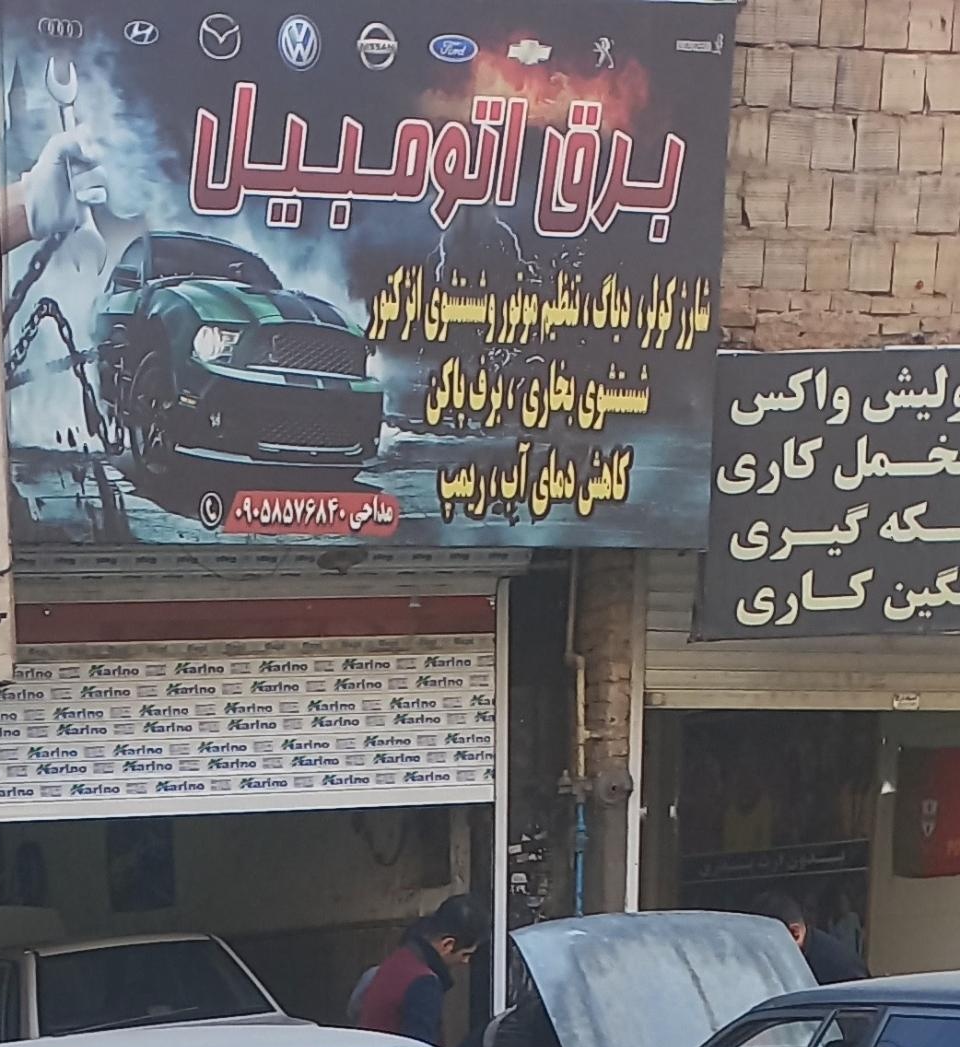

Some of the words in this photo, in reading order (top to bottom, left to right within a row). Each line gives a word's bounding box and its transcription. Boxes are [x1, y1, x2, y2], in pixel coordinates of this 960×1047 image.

[439, 40, 467, 57] Ford
[190, 81, 528, 229] اتومبیل
[536, 100, 685, 243] برق
[368, 264, 423, 341] انژکتور
[497, 271, 538, 345] موتور
[539, 268, 580, 345] تنظیم
[675, 276, 711, 350] شارژ
[426, 356, 465, 429] پاکن
[469, 354, 503, 428] برف
[577, 361, 650, 430] شستشوی
[729, 365, 851, 426] واکس
[531, 448, 575, 516] دمای
[578, 449, 631, 516] کاهش
[716, 436, 824, 494] کاری
[833, 433, 960, 491] خمل
[235, 496, 346, 525] ۰۹۰۵۸۵۷۶۸۴۰
[349, 494, 394, 530] مداحی
[729, 503, 870, 561] گیری
[878, 500, 960, 543] که
[735, 568, 875, 626] کاری
[883, 565, 960, 621] گین
[453, 751, 496, 762] Karin
